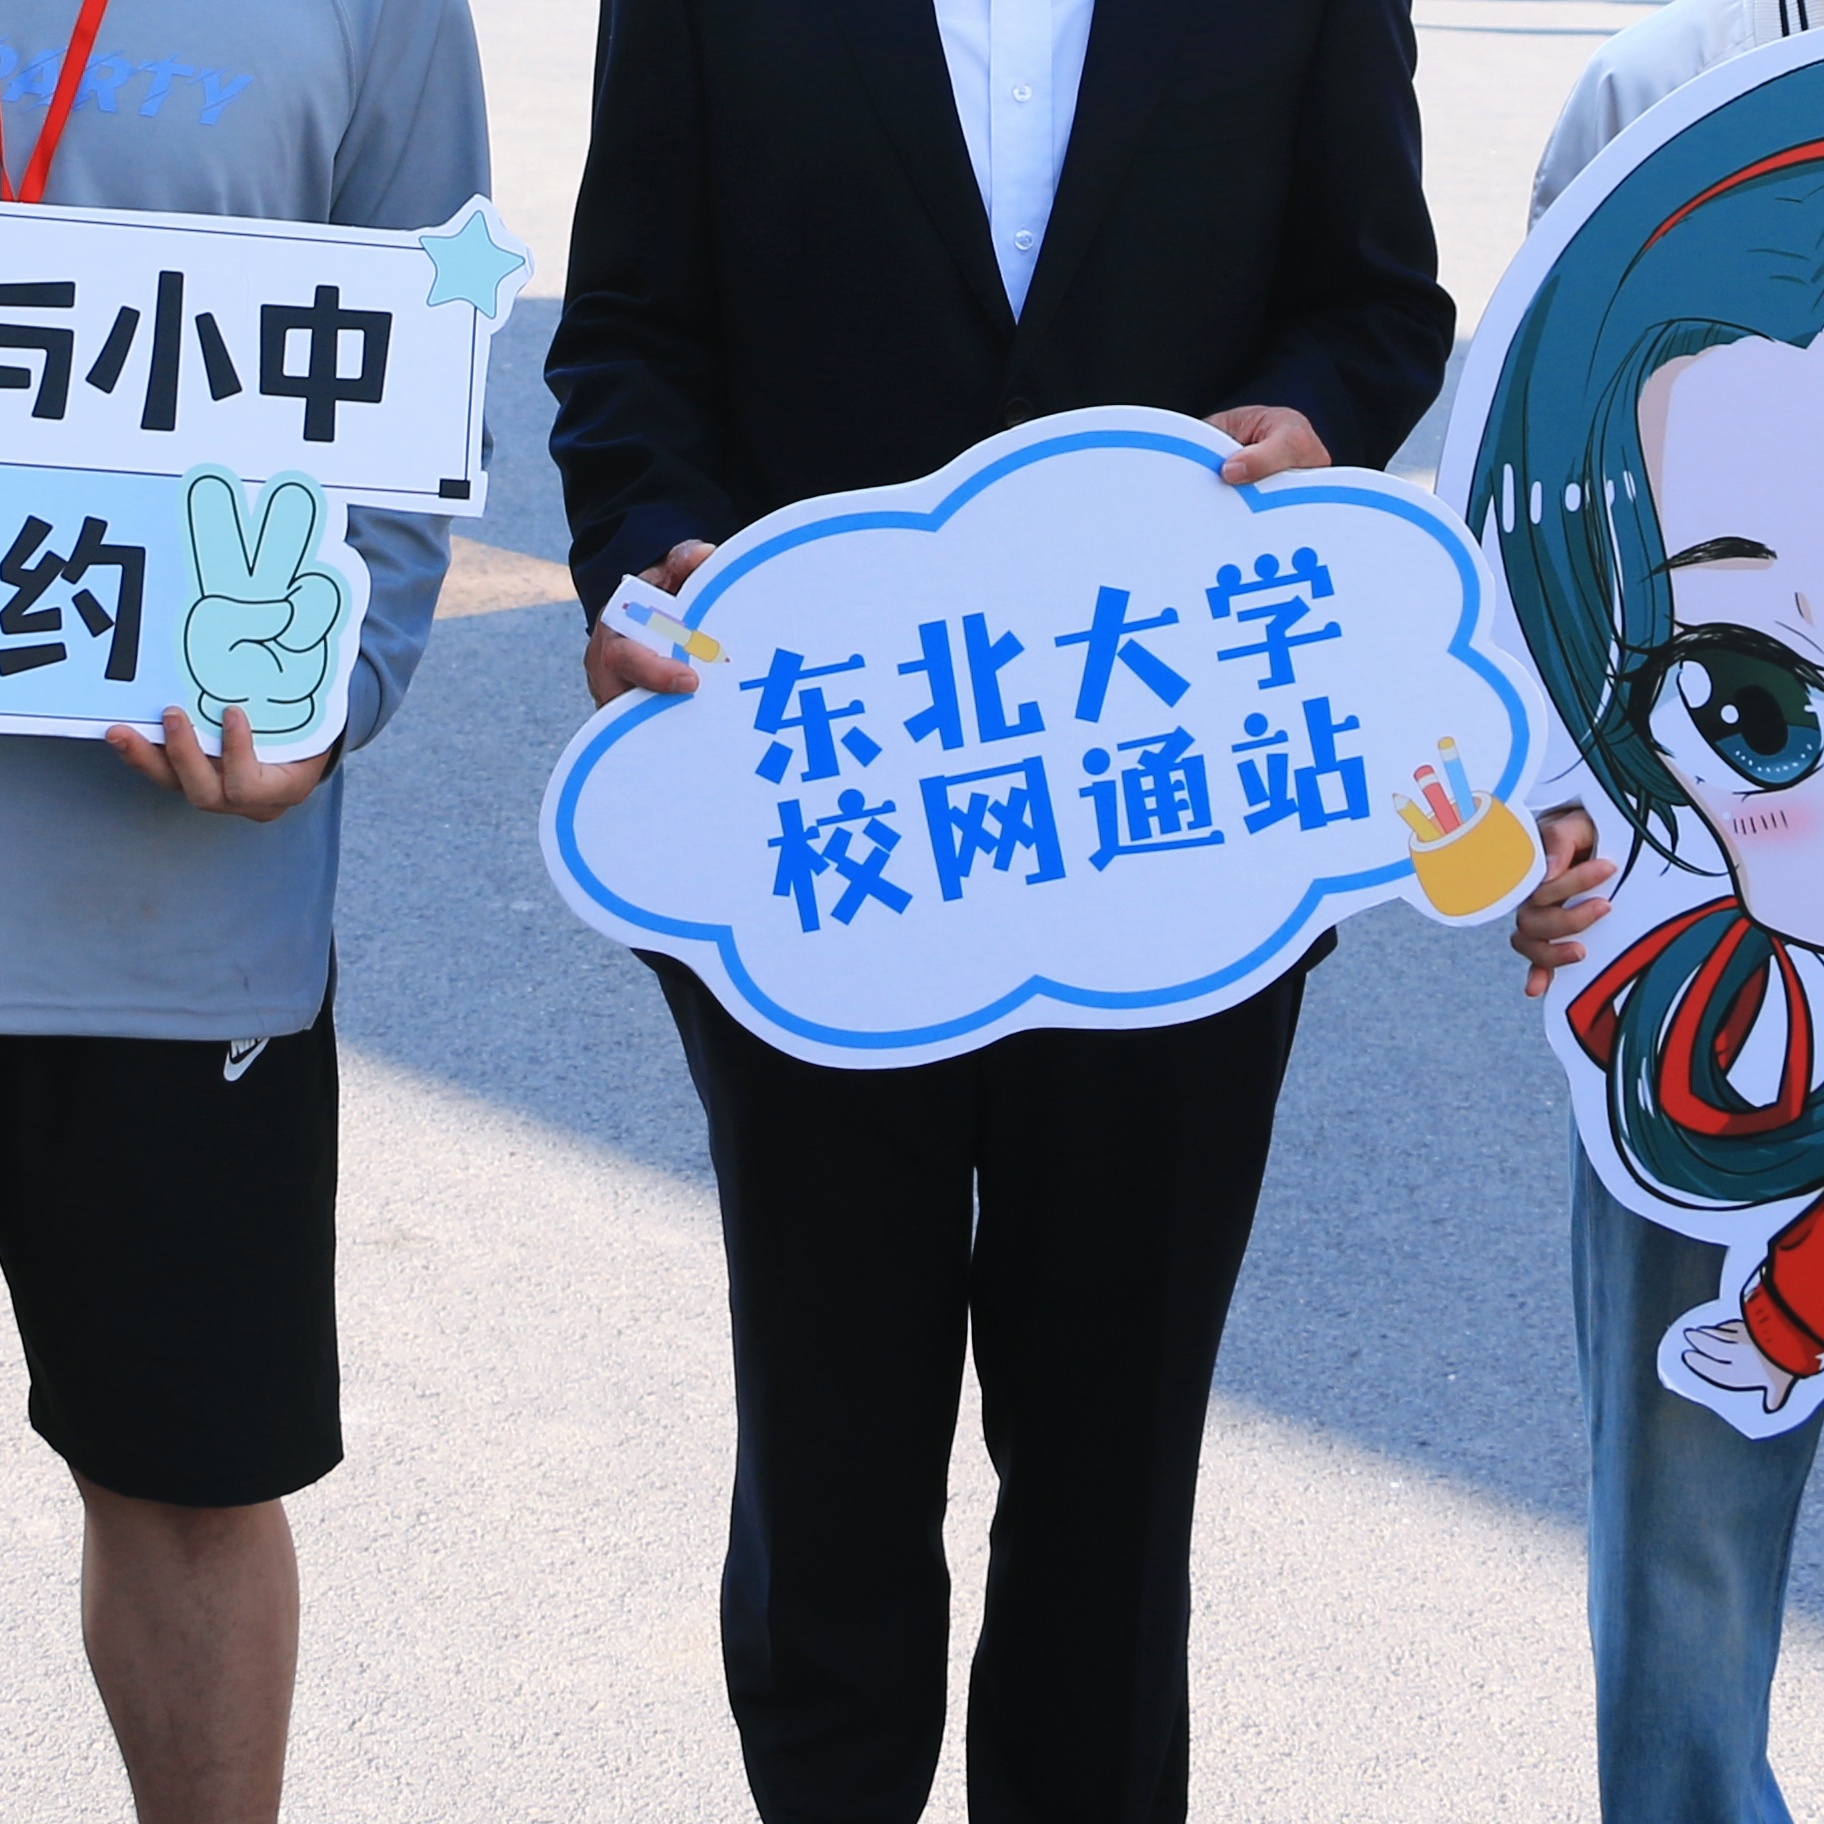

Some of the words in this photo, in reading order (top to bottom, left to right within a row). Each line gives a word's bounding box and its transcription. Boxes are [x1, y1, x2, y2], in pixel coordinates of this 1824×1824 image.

[739, 546, 1343, 785] 东北大学
[767, 696, 1371, 934] 校网通站
